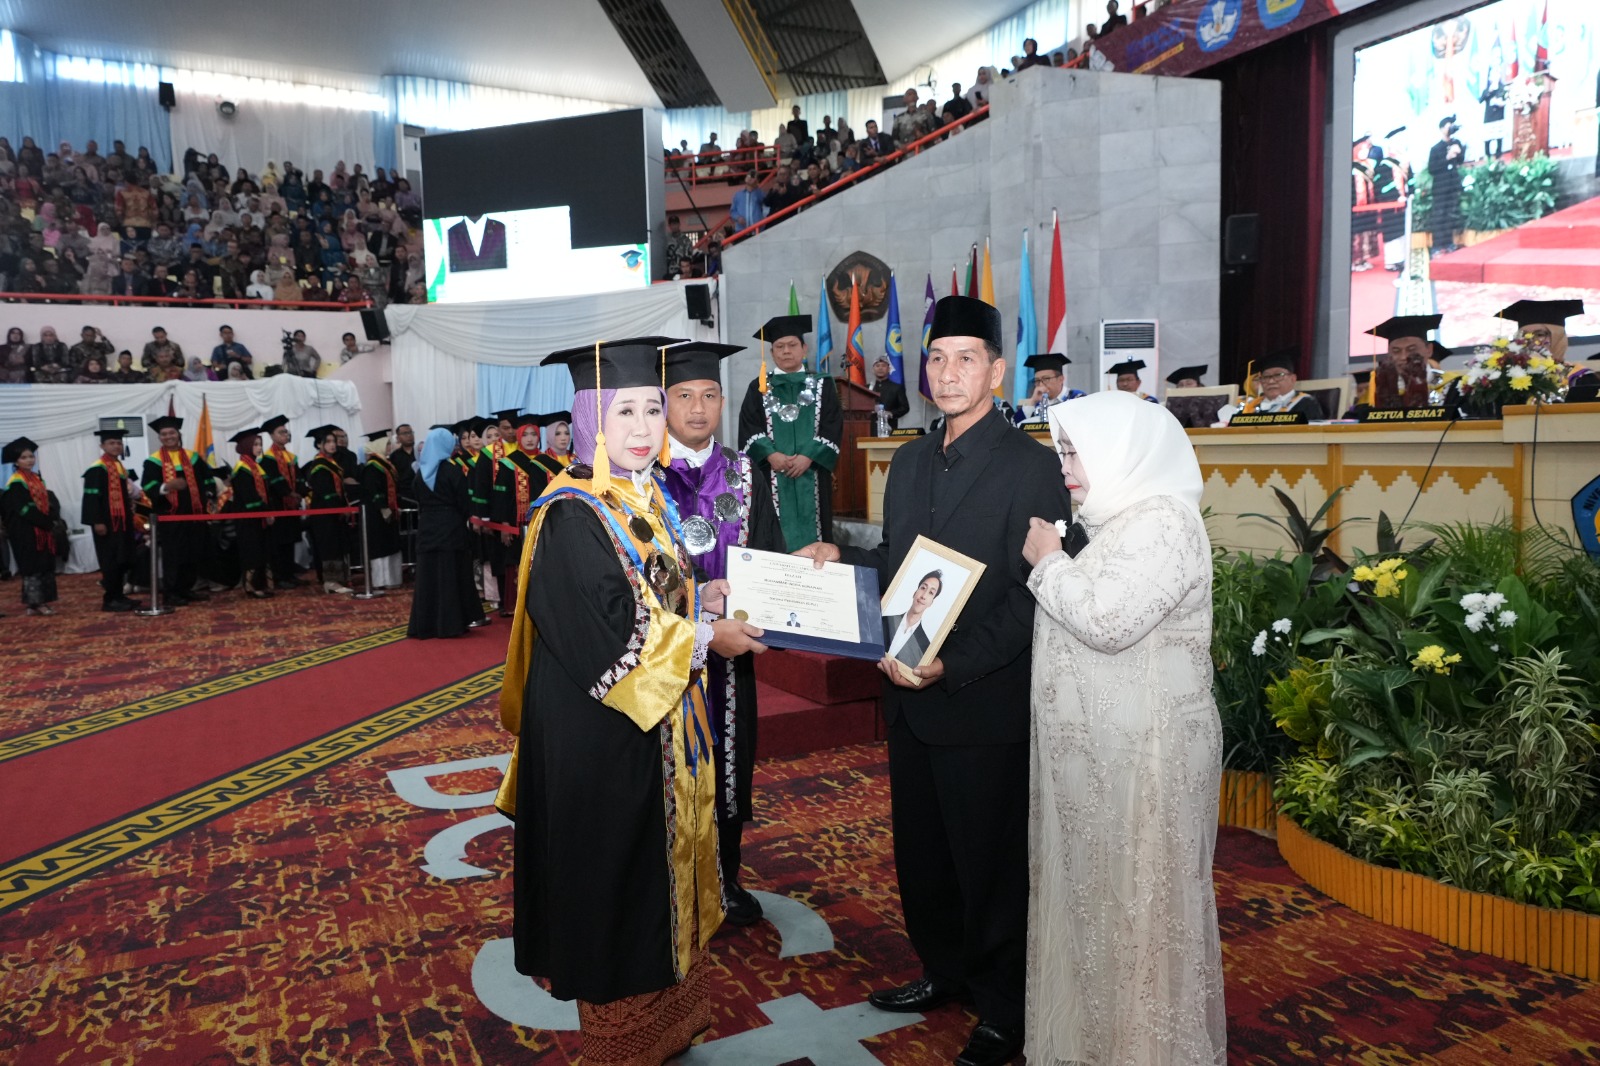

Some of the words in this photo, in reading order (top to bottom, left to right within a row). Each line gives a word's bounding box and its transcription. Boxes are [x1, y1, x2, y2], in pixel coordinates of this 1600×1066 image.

[1231, 415, 1274, 424] SEKRETARIS
[1274, 414, 1298, 423] SENAT
[1367, 410, 1404, 420] KETUA
[1406, 408, 1445, 418] SENAT
